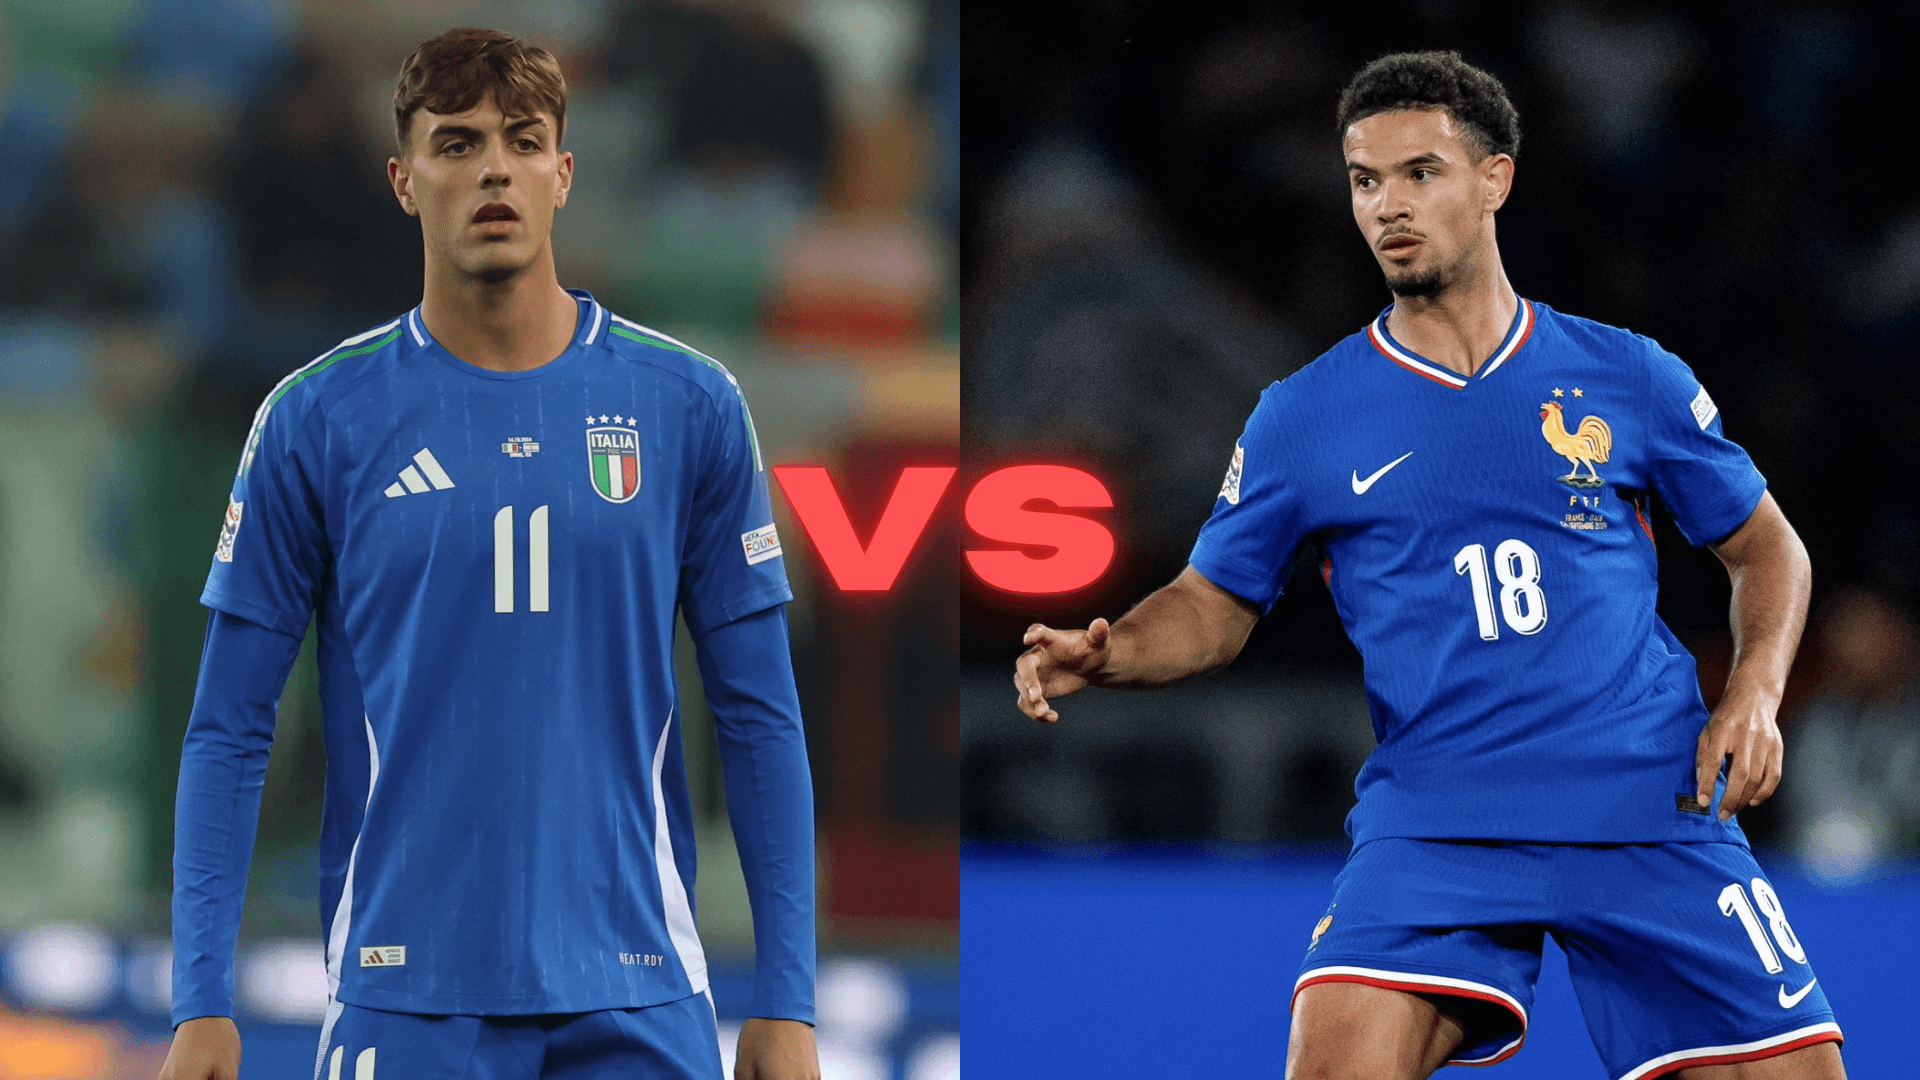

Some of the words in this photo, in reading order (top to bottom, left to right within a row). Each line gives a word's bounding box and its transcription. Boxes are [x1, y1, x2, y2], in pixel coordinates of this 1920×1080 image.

[591, 433, 635, 449] ITALIA
[493, 504, 550, 613] 11
[744, 532, 759, 542] UEFA
[1453, 538, 1548, 640] 18
[1716, 877, 1808, 975] 18
[618, 952, 664, 967] HEAT.RDY
